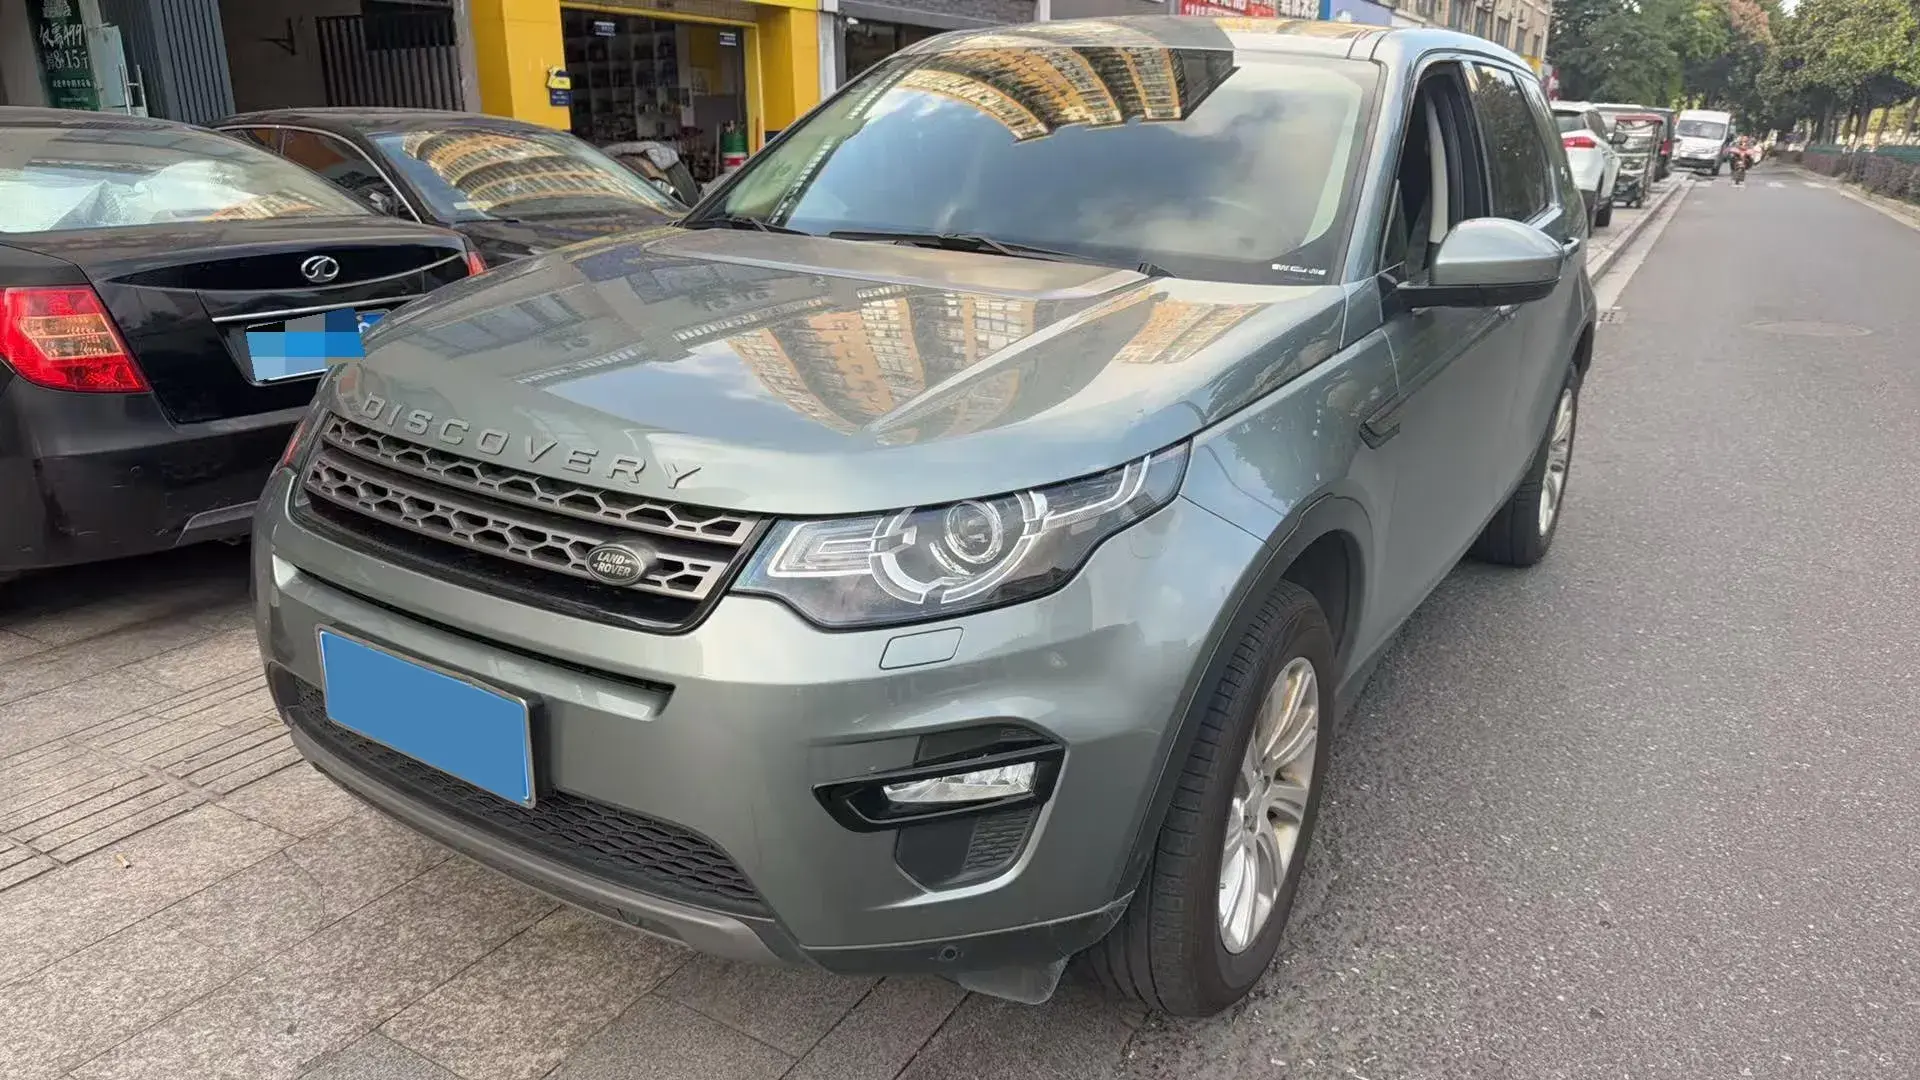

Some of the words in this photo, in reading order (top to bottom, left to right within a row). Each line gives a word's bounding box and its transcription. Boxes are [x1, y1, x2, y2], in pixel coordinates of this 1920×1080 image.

[359, 391, 702, 489] DISCOVERY
[597, 551, 625, 565] LAND
[597, 562, 631, 577] ROVER
